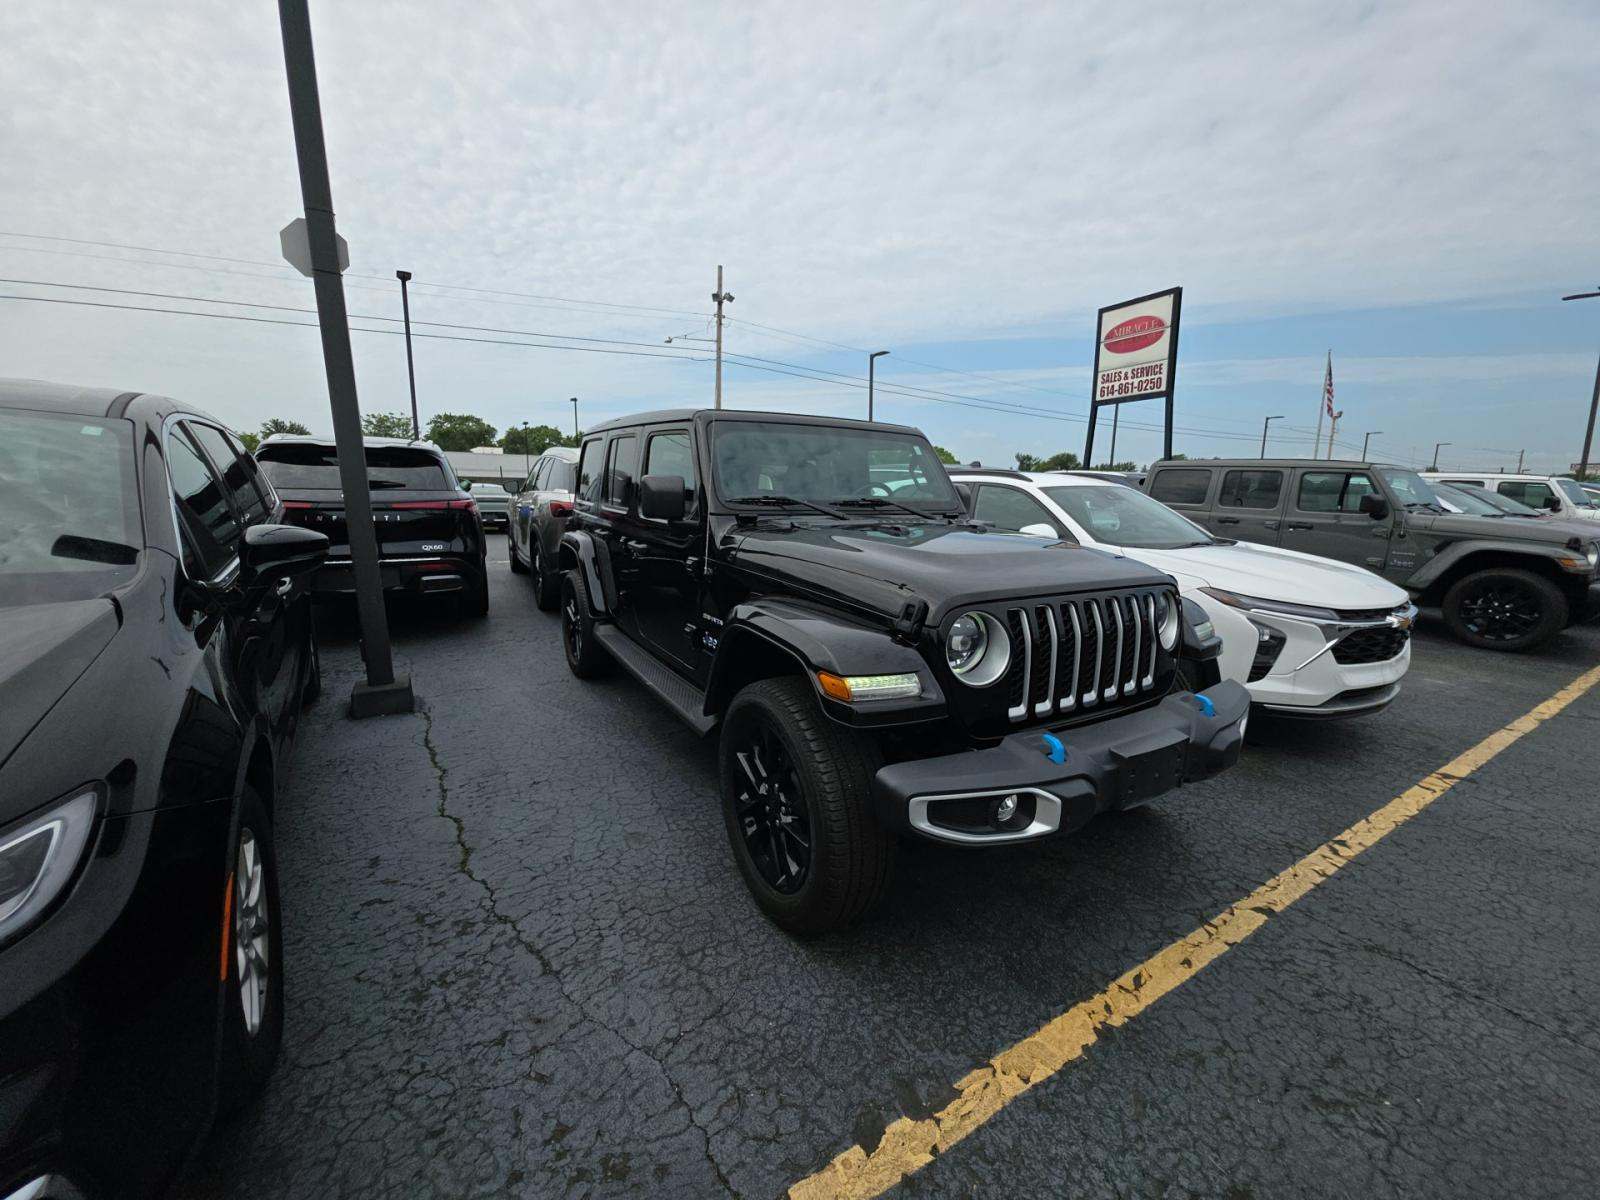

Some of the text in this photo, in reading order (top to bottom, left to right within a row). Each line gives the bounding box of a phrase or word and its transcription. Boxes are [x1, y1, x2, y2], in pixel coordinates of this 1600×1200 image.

[1101, 363, 1163, 384] SALES & SERVICE
[1099, 377, 1162, 397] 614-861-0250
[304, 514, 400, 522] INFITI
